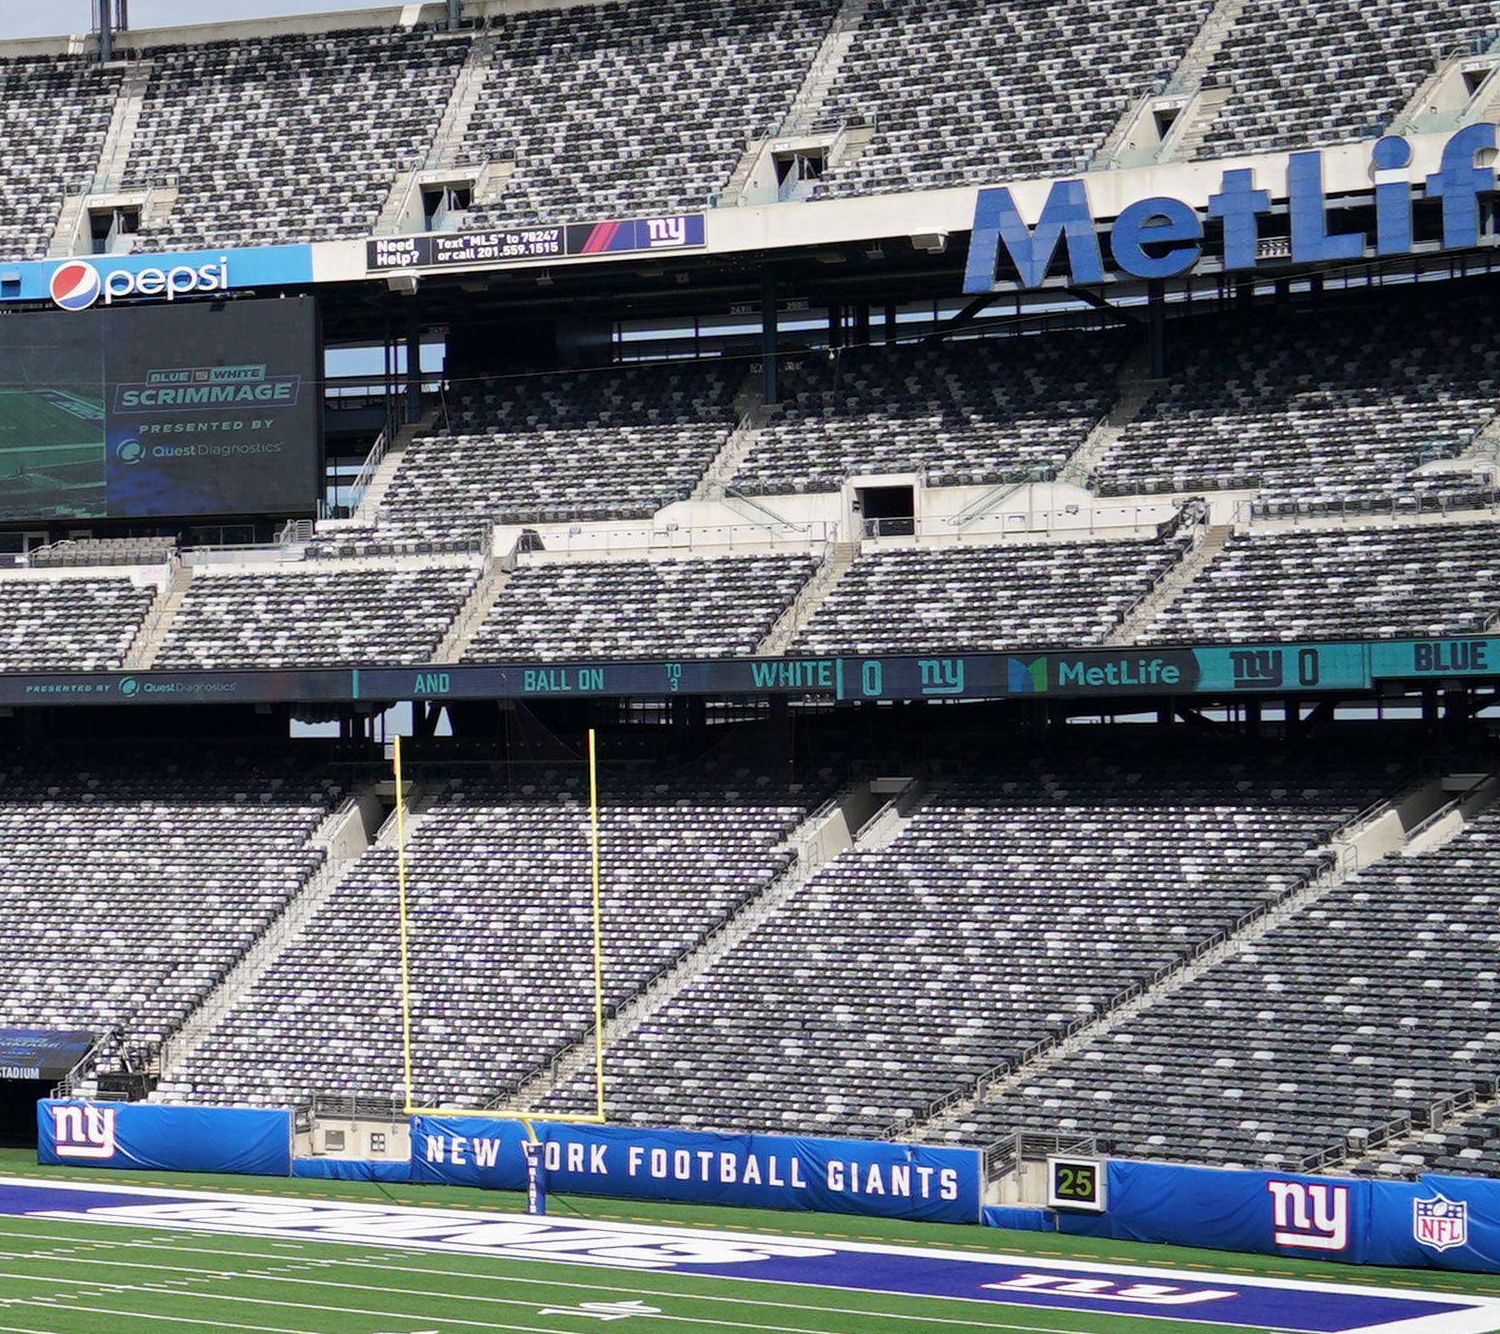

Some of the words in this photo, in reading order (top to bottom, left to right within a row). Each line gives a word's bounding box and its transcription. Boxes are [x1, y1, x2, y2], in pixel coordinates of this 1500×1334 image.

[963, 123, 1500, 294] MetLif
[377, 238, 414, 253] Need
[522, 230, 558, 243] 78247
[648, 218, 686, 247] ny
[377, 249, 420, 265] Help?
[477, 241, 559, 258] 201.559.1515
[105, 256, 228, 304] pepsi
[150, 371, 190, 382] BLUE
[212, 369, 261, 380] WHITE
[122, 383, 293, 406] SCRIMMAGE
[139, 421, 243, 434] PRESENTED
[252, 419, 274, 429] BY
[1229, 650, 1283, 687] ny
[1414, 642, 1488, 672] BLUE
[413, 673, 449, 692] AND
[524, 670, 572, 691] BALL
[578, 669, 604, 689] ON
[665, 664, 682, 678] TO
[750, 662, 831, 688] WHITE
[918, 659, 964, 695] ny
[1059, 660, 1180, 686] MetLife
[52, 1105, 115, 1159] ny
[426, 1137, 500, 1168] NEW
[628, 1147, 807, 1188] FOOTBALL
[828, 1161, 957, 1201] GIANTS
[1058, 1169, 1092, 1196] 25
[1268, 1181, 1349, 1251] ny
[1422, 1218, 1461, 1242] NFL
[978, 1273, 1242, 1305] ny
